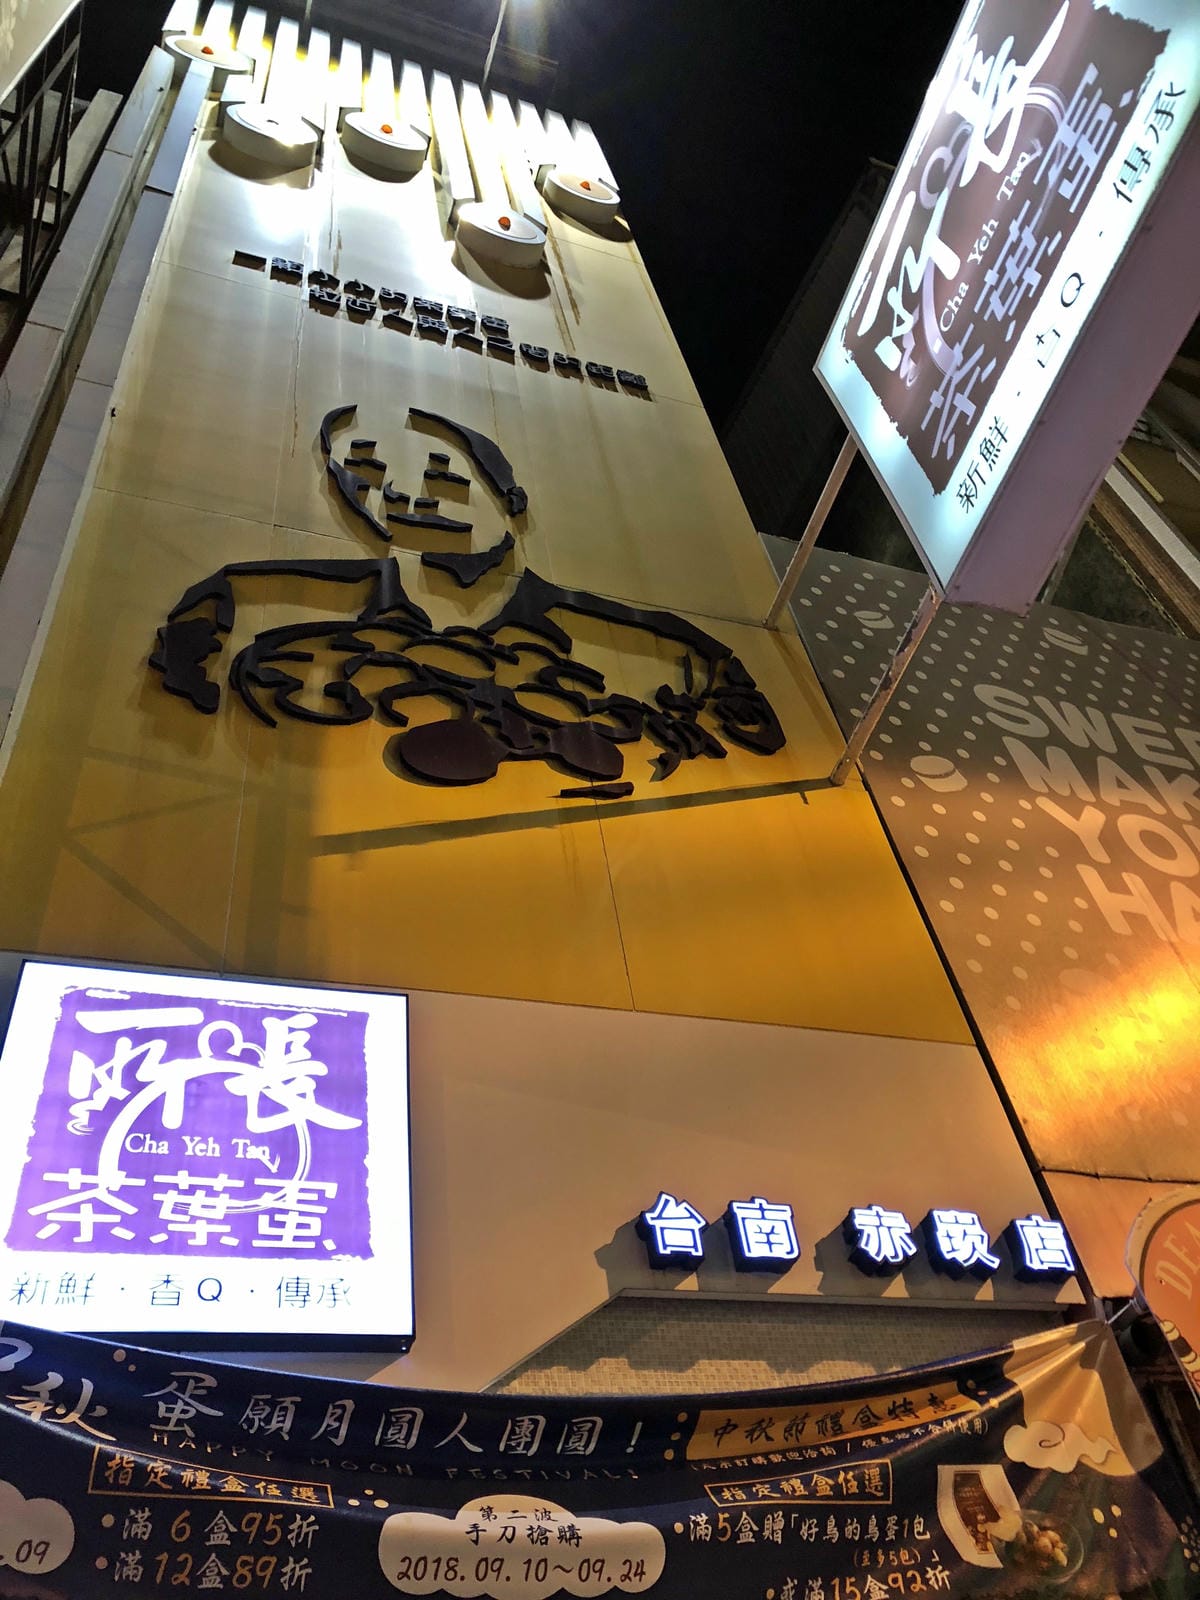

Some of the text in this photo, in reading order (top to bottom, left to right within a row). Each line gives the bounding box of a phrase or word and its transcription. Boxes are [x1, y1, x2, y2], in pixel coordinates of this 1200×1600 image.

[921, 63, 1134, 460] 茶葉蛋
[939, 282, 970, 333] Cha
[966, 216, 1000, 267] Yeh
[956, 415, 1009, 514] 新鮮
[1035, 796, 1200, 877] YO
[125, 1133, 169, 1156] Cha
[182, 1136, 221, 1158] Yeh
[28, 1167, 338, 1251] 茶葉蛋
[9, 1271, 96, 1306] 新鮮
[276, 1275, 352, 1309] 傳承
[105, 1453, 322, 1503] 指定禮盒任選
[721, 1466, 885, 1501] 指定禮盒任選
[465, 1523, 583, 1547] 手刀搶購
[479, 1506, 558, 1523] 第二波
